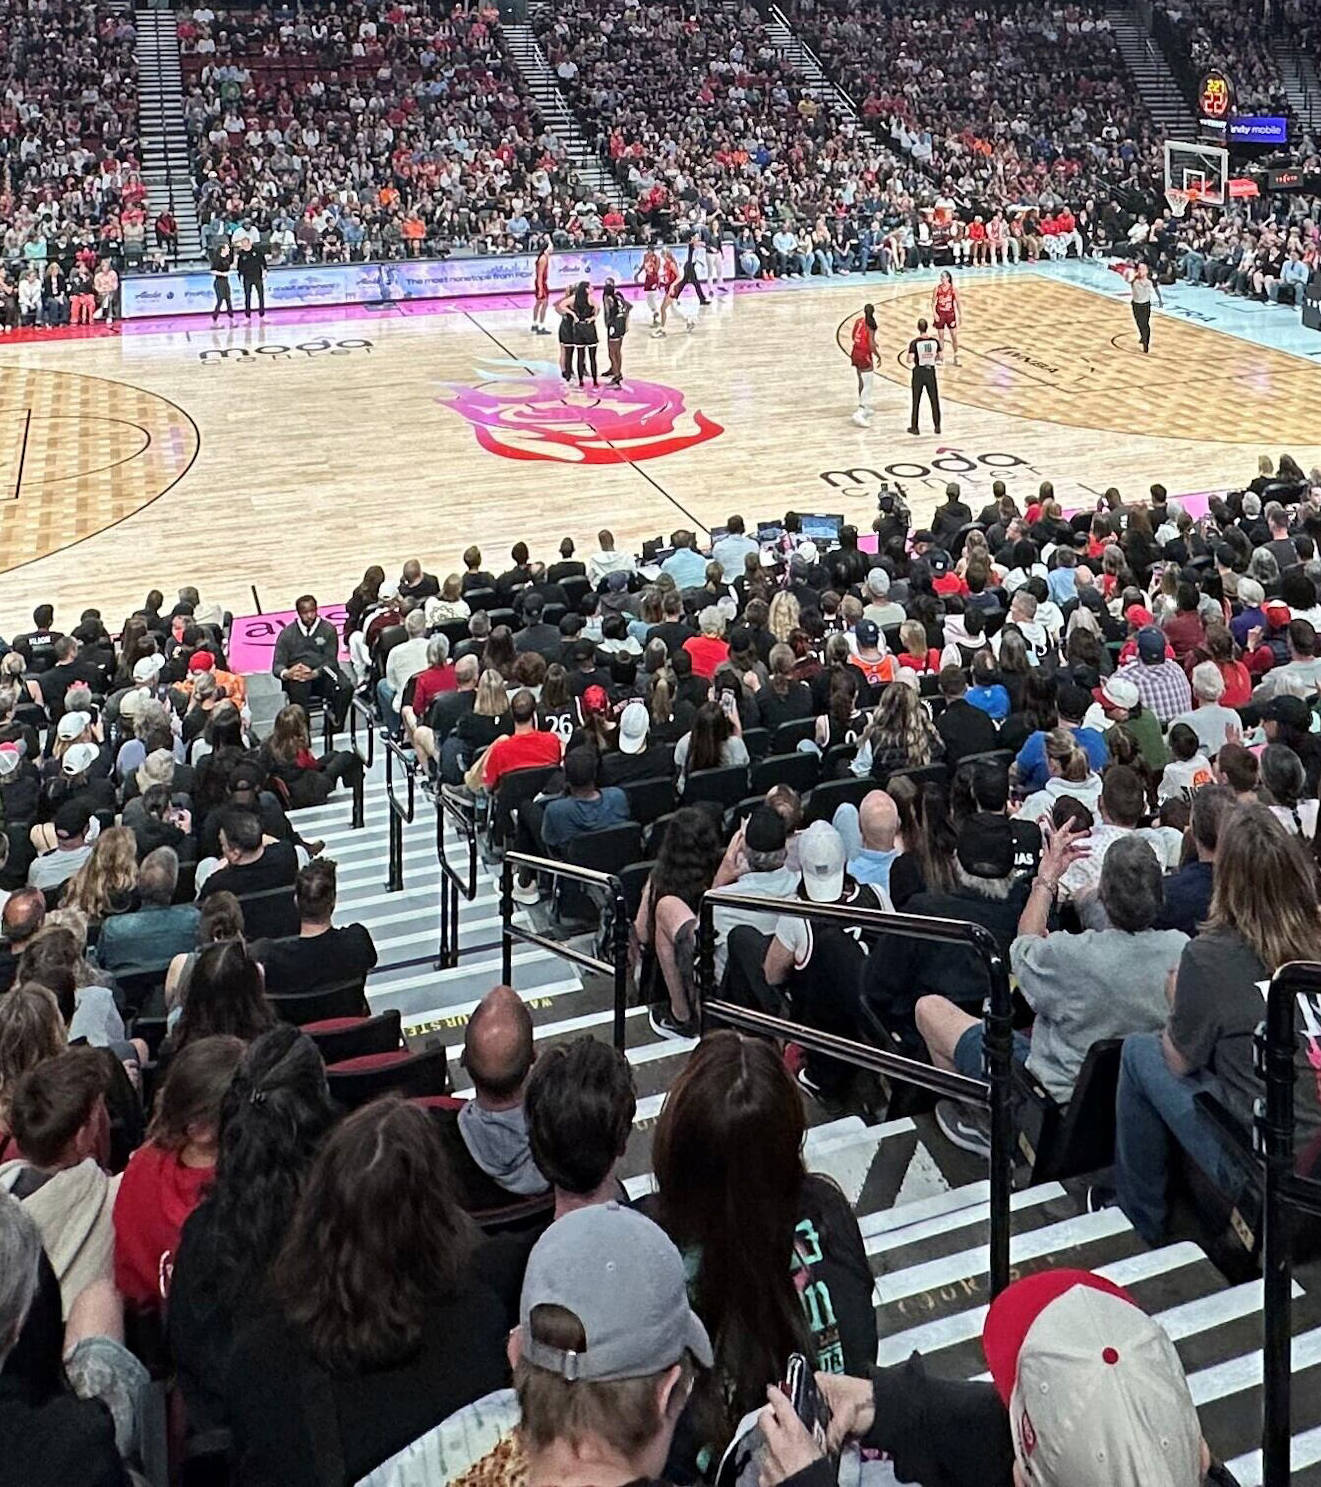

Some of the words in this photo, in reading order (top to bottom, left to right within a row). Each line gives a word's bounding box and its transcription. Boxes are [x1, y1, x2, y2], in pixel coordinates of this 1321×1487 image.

[199, 336, 375, 360] moda
[819, 452, 1031, 488] moda
[841, 466, 1042, 498] cnter
